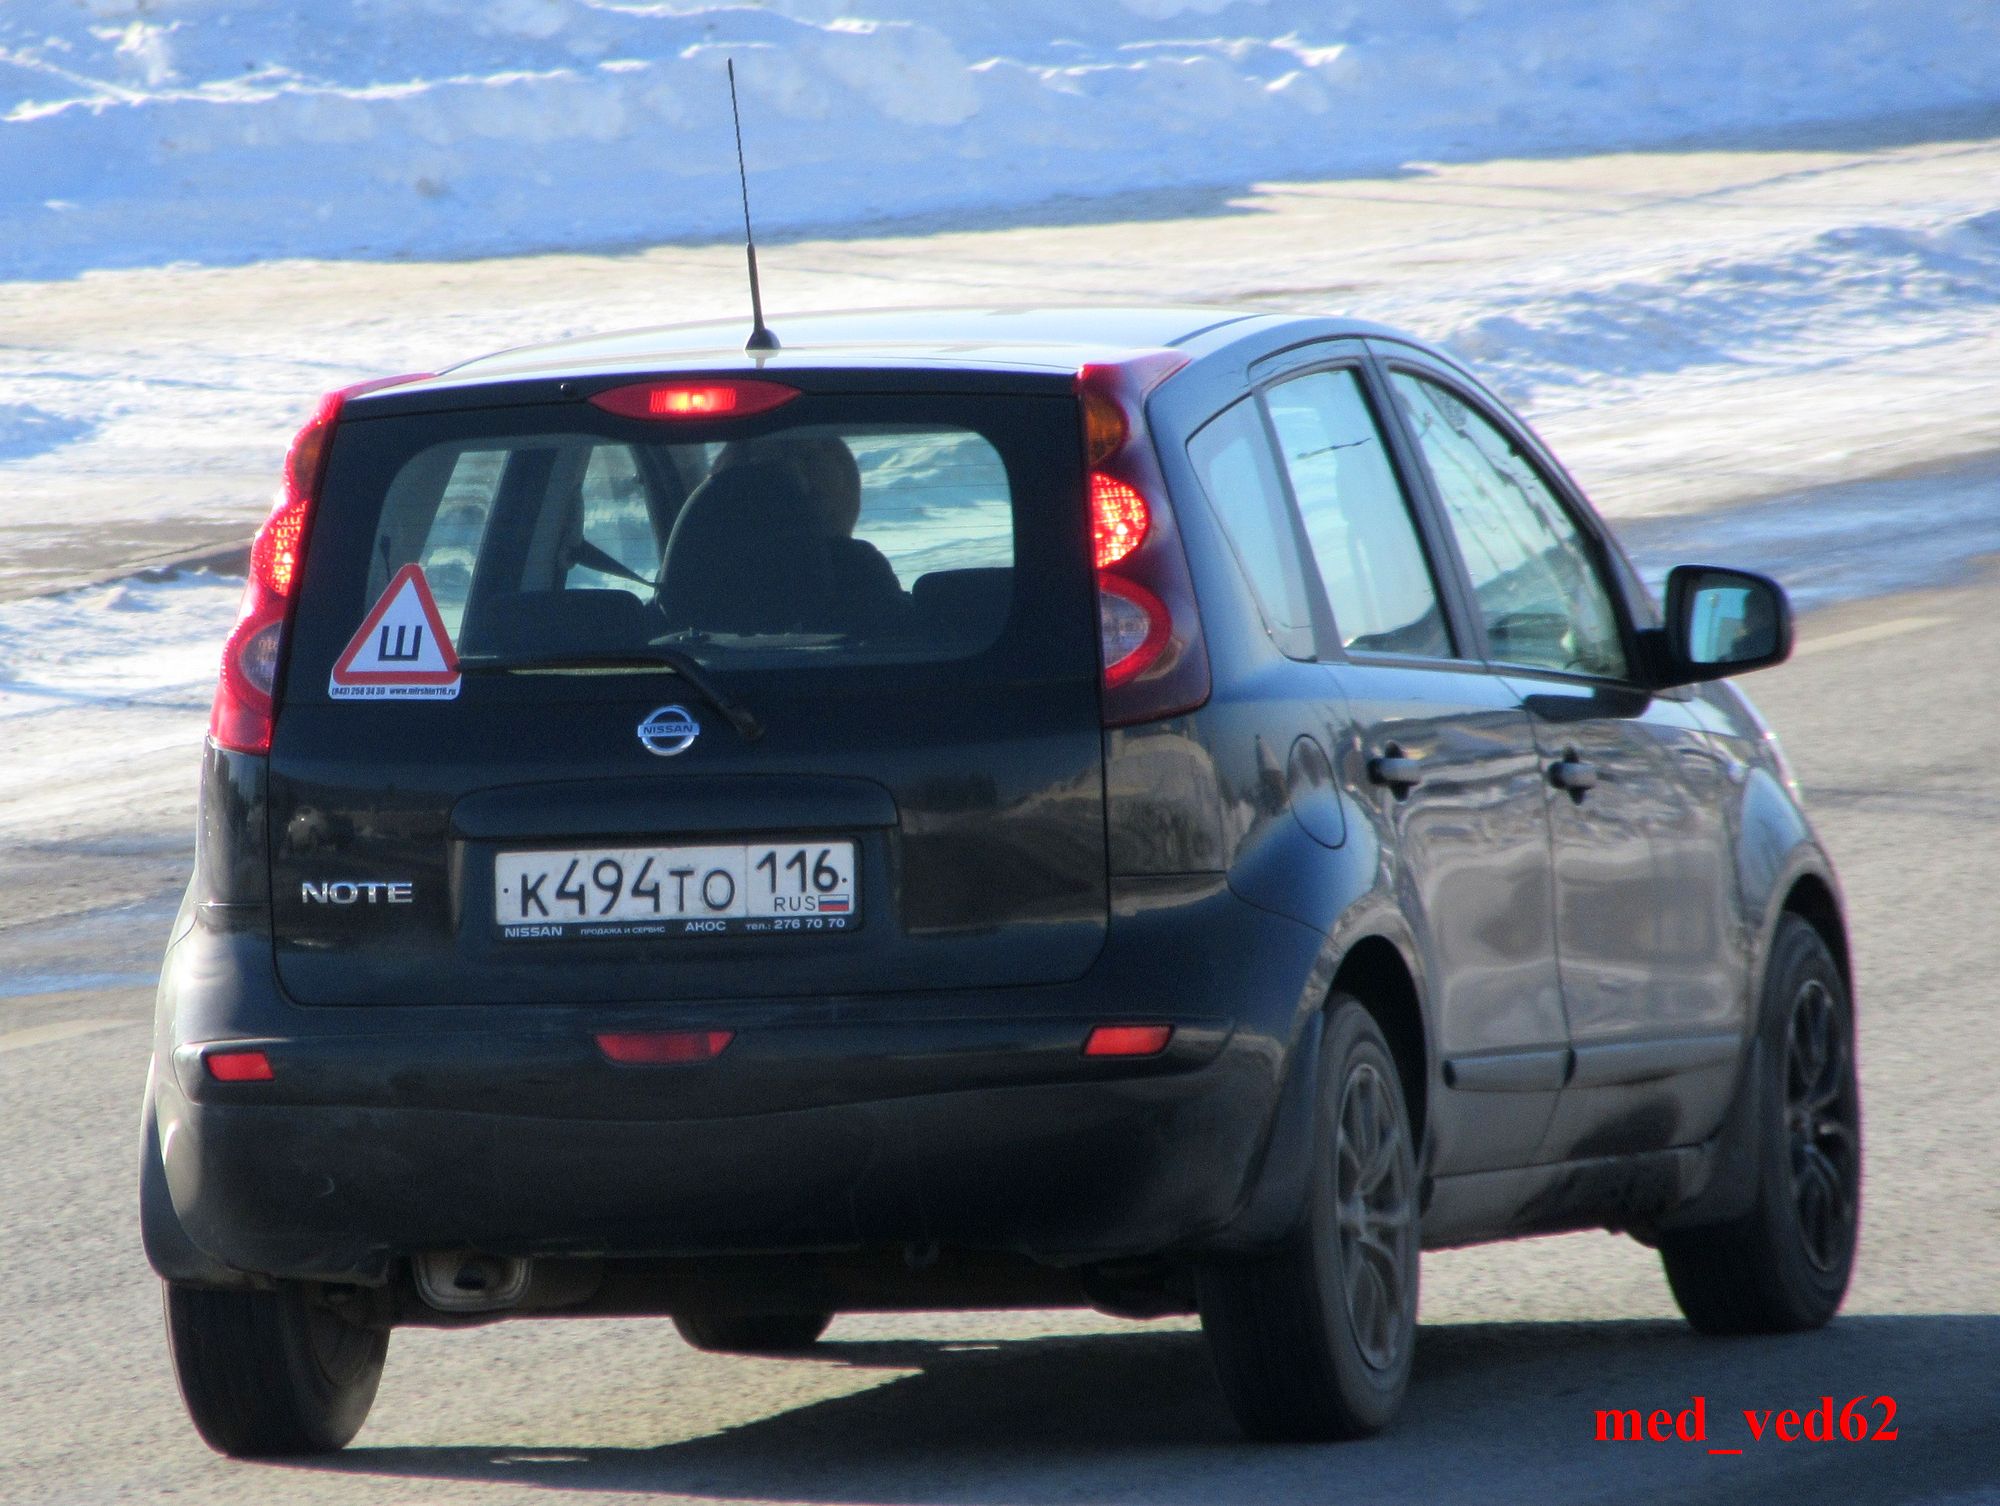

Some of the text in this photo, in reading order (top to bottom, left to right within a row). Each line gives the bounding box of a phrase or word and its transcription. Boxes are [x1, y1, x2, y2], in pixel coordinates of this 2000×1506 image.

[378, 625, 423, 661] Ш
[643, 725, 693, 735] NISSAN
[756, 850, 840, 894] 116
[301, 880, 413, 904] NOTE
[774, 897, 817, 912] RUS
[774, 919, 801, 930] 276
[806, 918, 823, 929] 70
[828, 918, 845, 928] 70
[504, 926, 563, 938] NISSAN
[580, 927, 623, 936] ПРОДАЖА
[632, 926, 666, 934] СЕРВИС
